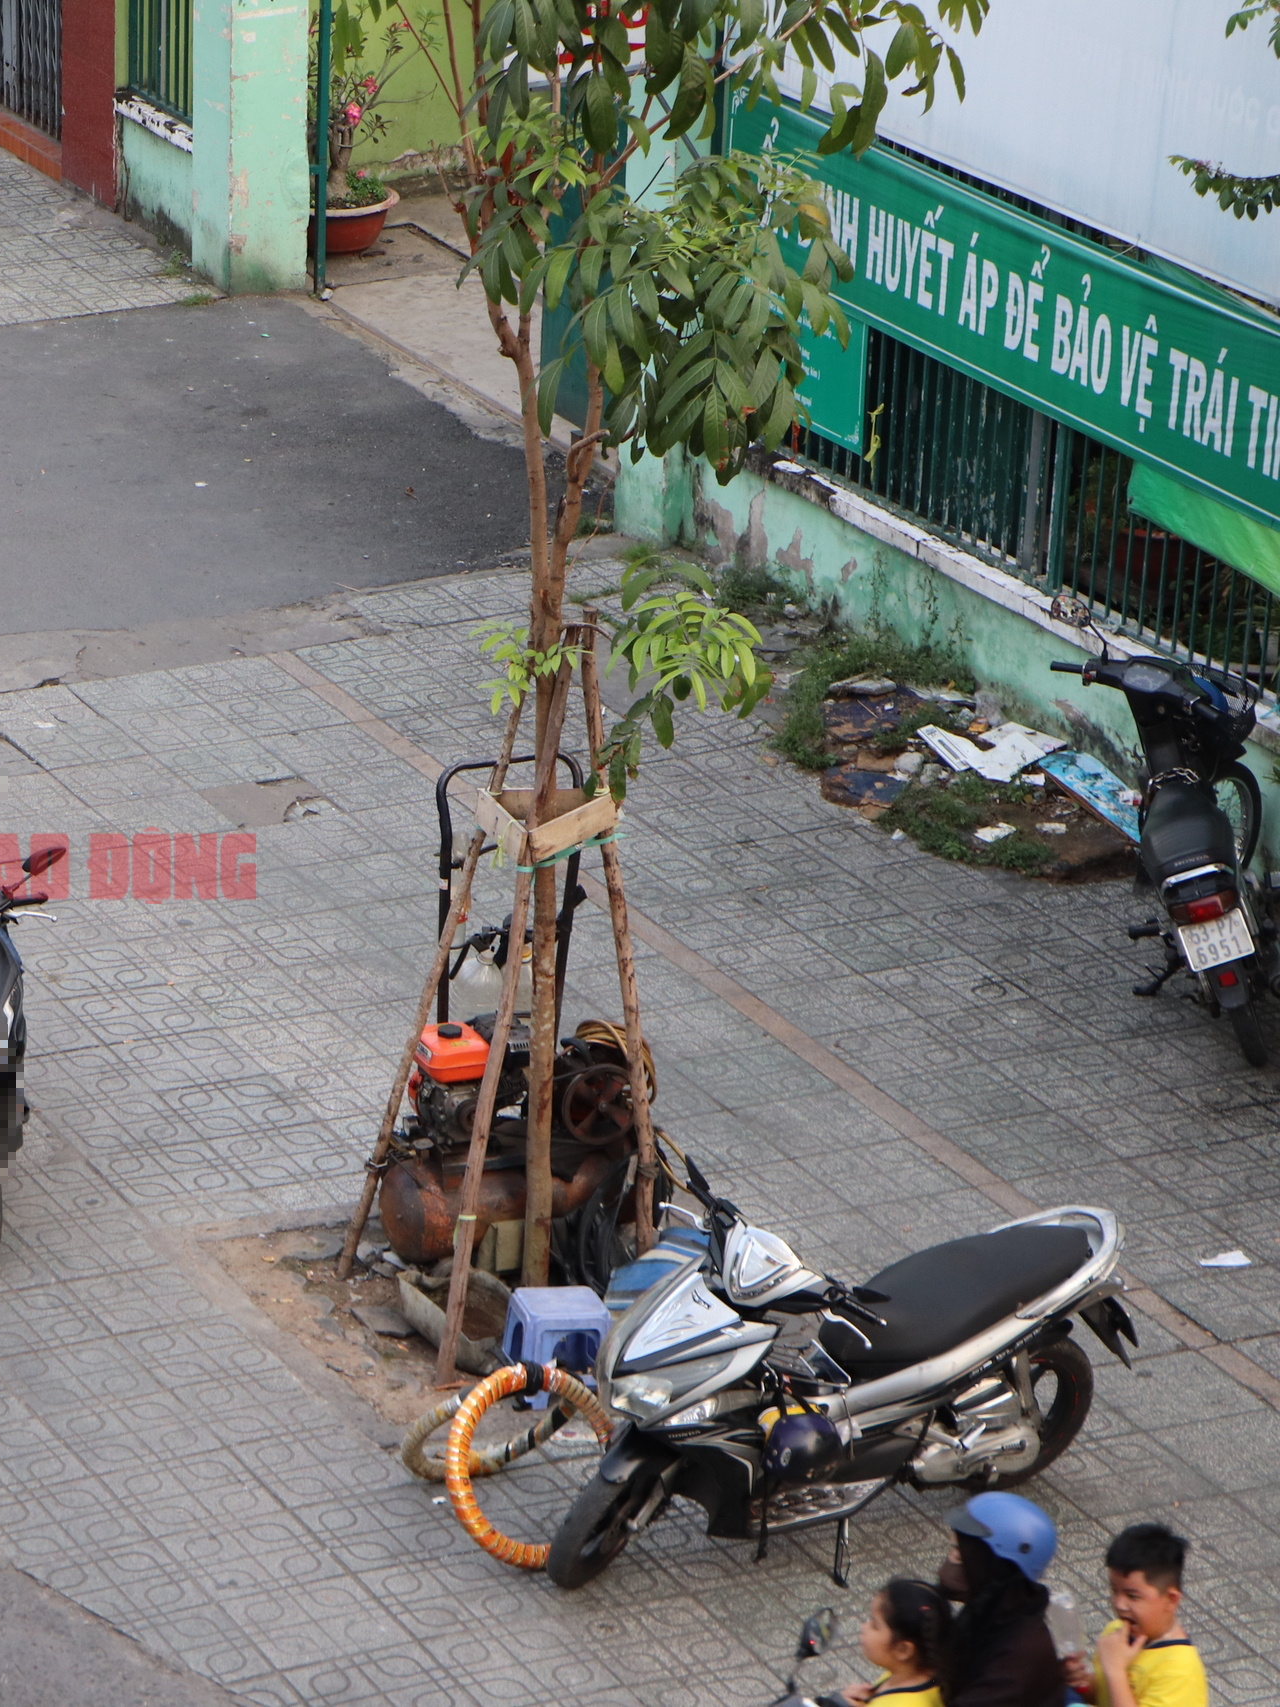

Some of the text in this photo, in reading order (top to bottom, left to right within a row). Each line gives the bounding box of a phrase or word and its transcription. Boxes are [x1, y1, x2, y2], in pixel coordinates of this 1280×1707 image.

[865, 205, 955, 317] HUYẾT
[958, 232, 999, 336] ÁP
[1004, 244, 1051, 363] ĐỂ
[1051, 274, 1112, 395] BẢO
[1121, 314, 1159, 433] VỆ
[1168, 347, 1240, 459] TRÁI
[1247, 384, 1280, 481] TI
[1196, 935, 1242, 965] 6951
